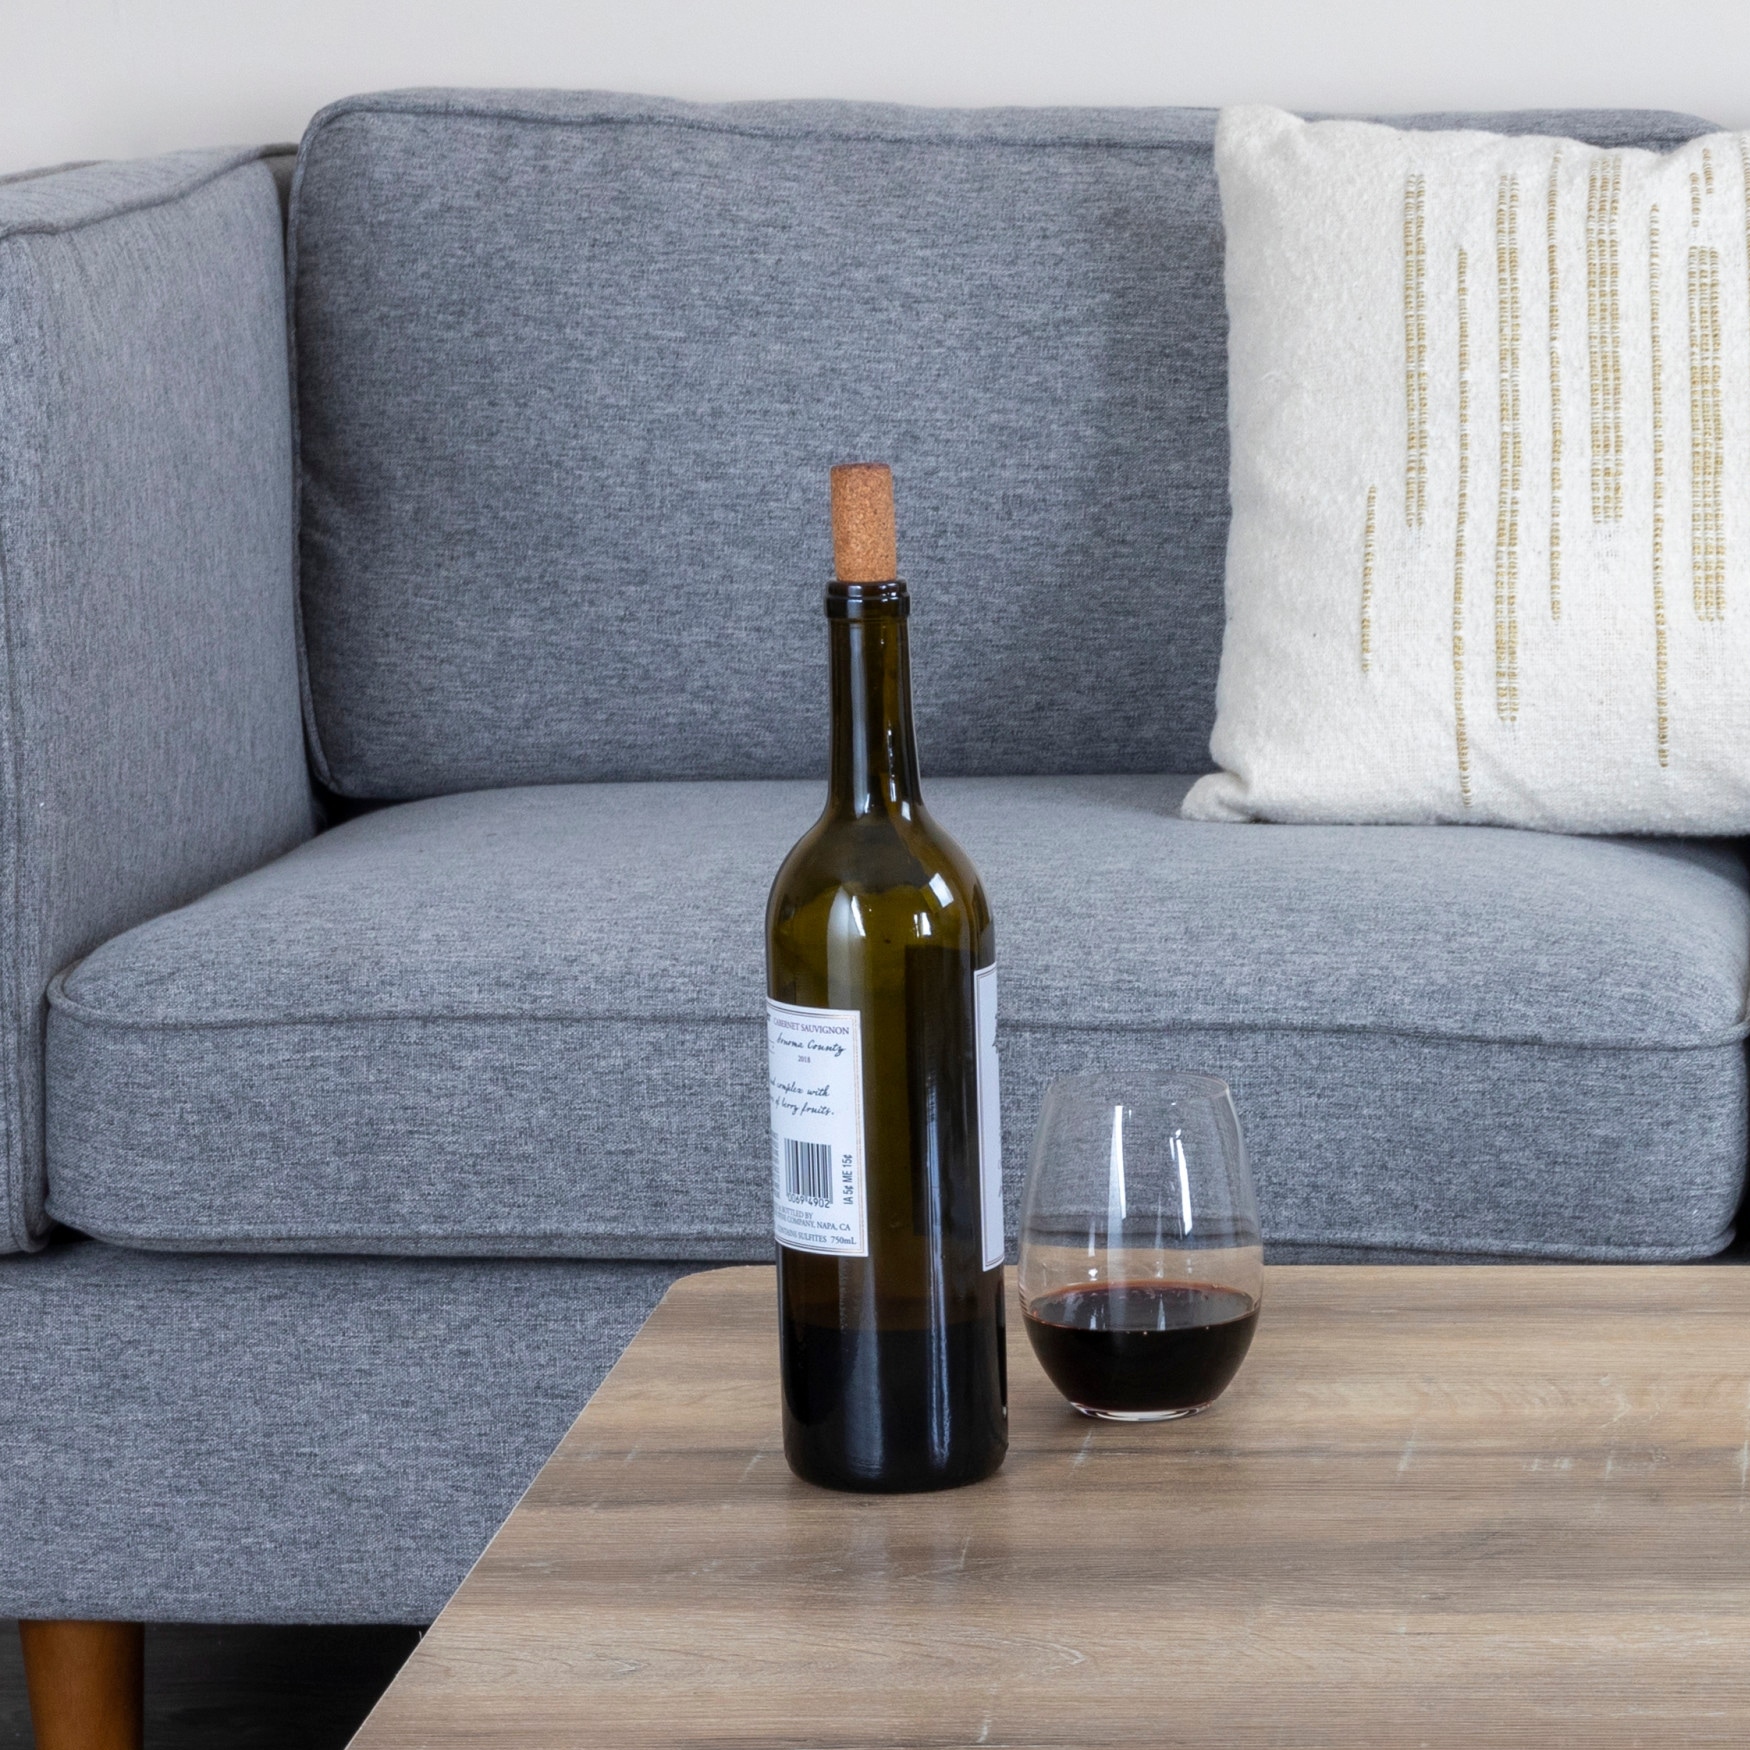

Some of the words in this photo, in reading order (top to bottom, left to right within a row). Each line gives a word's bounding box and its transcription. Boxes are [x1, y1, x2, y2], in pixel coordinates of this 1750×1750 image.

[773, 1017, 800, 1031] CABERNET
[801, 1024, 850, 1035] SAUVIGNON
[807, 1039, 846, 1057] County
[807, 1084, 830, 1097] with
[842, 1170, 853, 1183] ME
[816, 1221, 838, 1231] NAPA,
[839, 1223, 851, 1231] CA
[798, 1230, 828, 1243] SULFITES
[830, 1235, 857, 1245] 750mL
